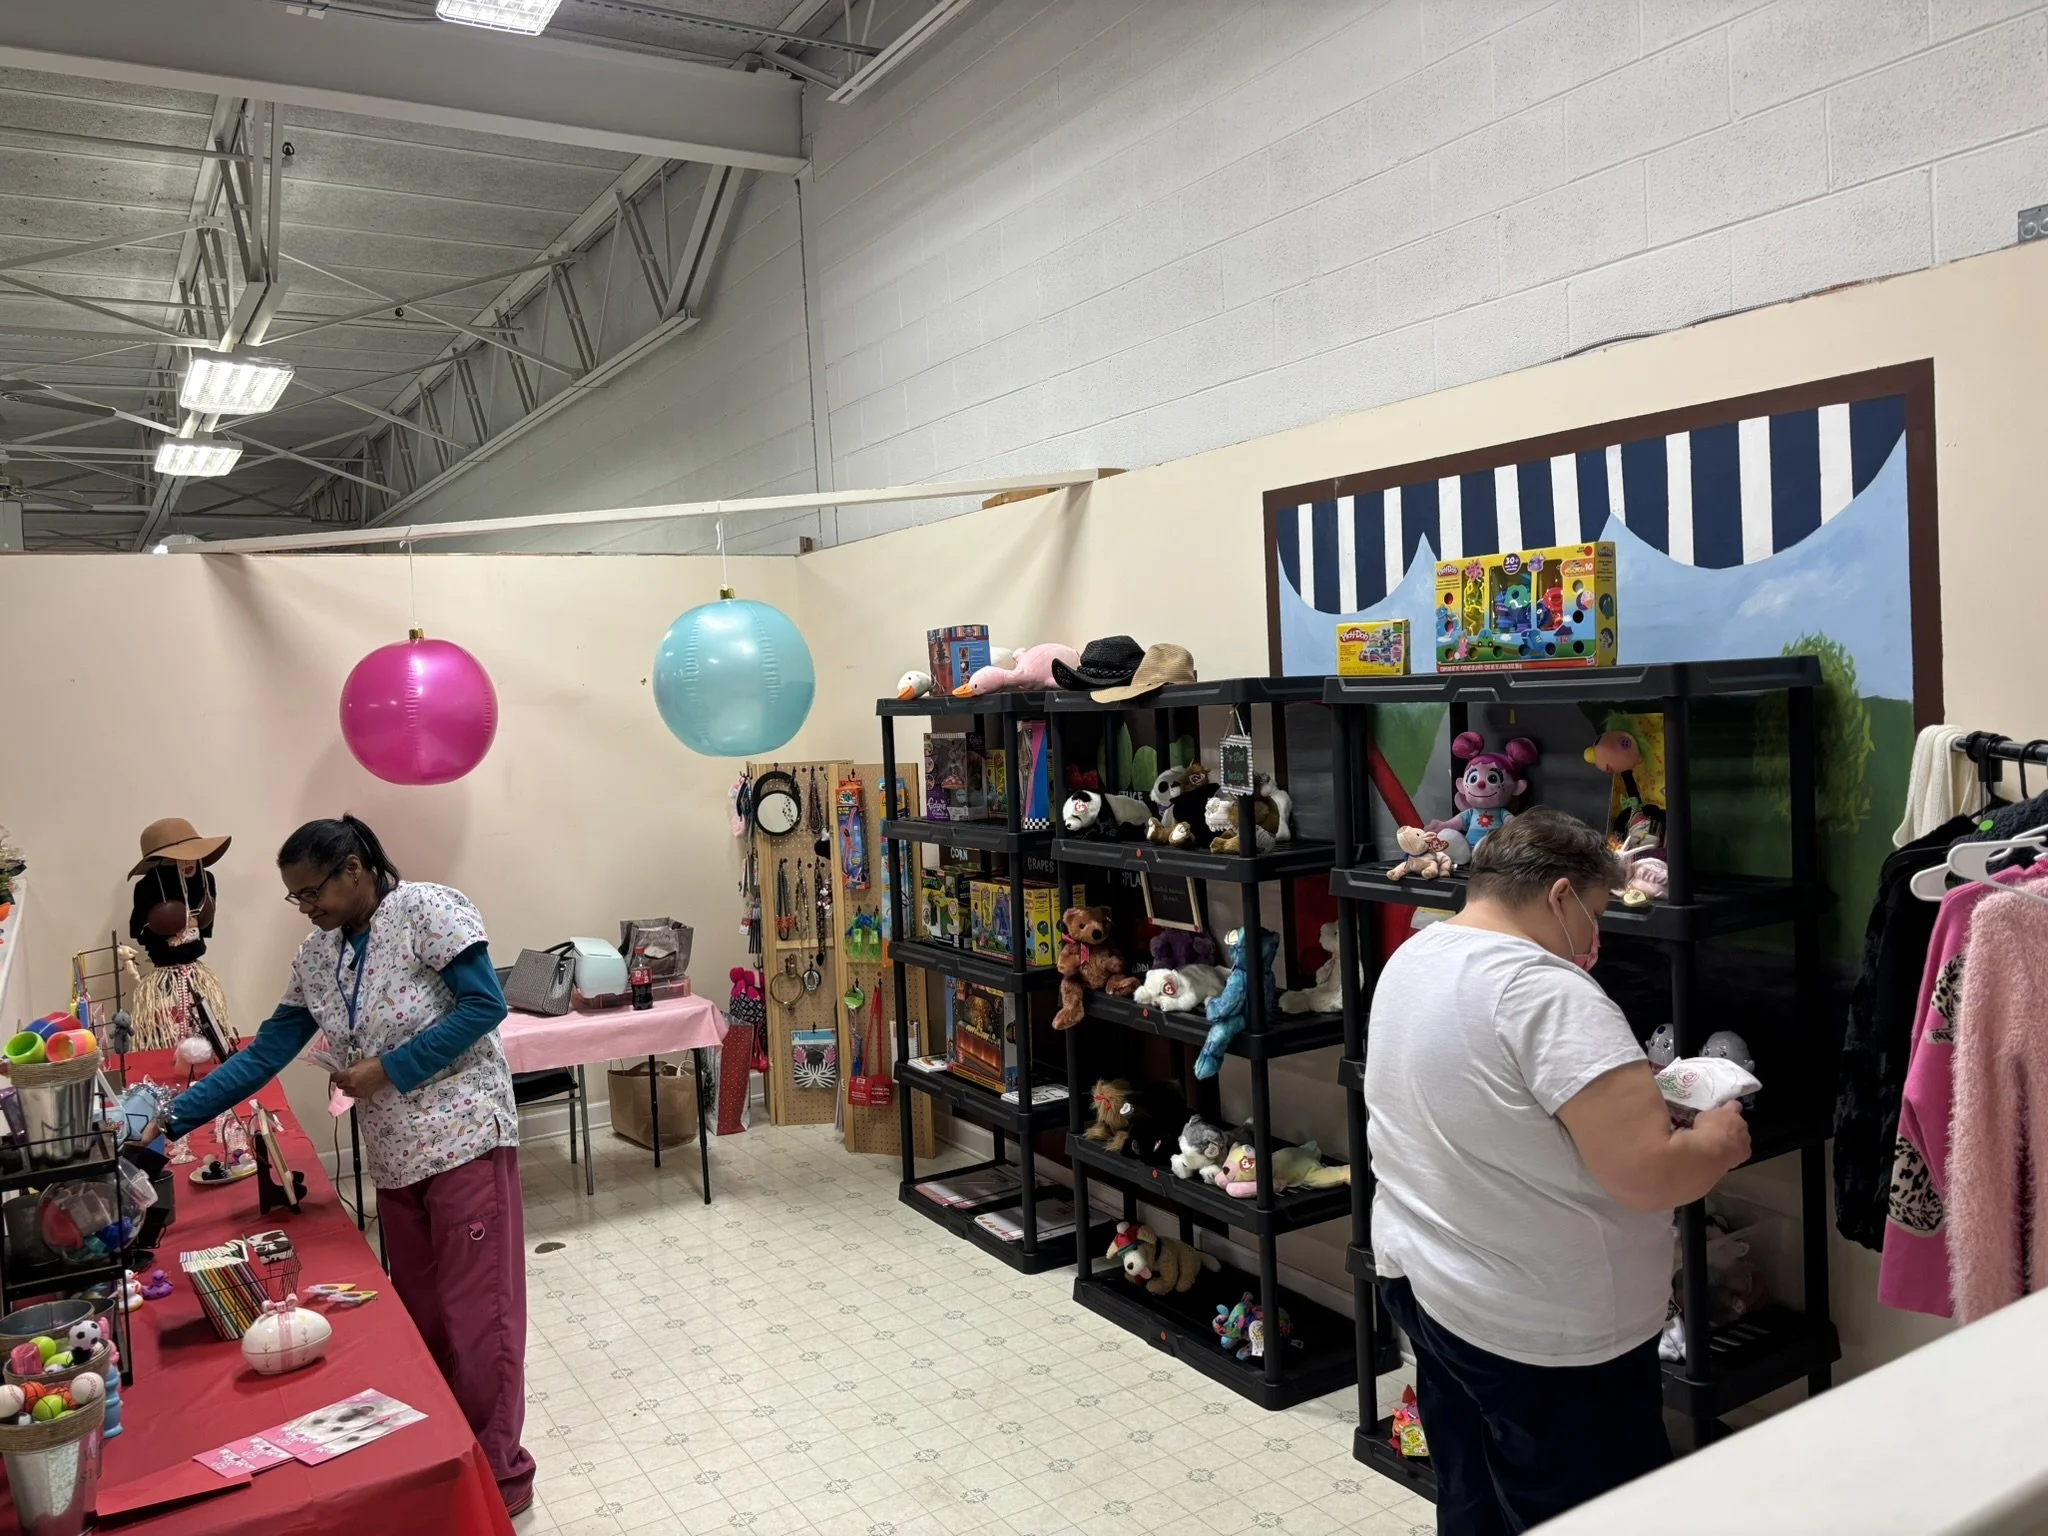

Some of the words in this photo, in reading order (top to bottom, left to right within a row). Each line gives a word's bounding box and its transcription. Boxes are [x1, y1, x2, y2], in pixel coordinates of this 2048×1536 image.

[1585, 563, 1593, 571] 10
[950, 847, 968, 861] CORN
[1027, 857, 1055, 873] GRAPES
